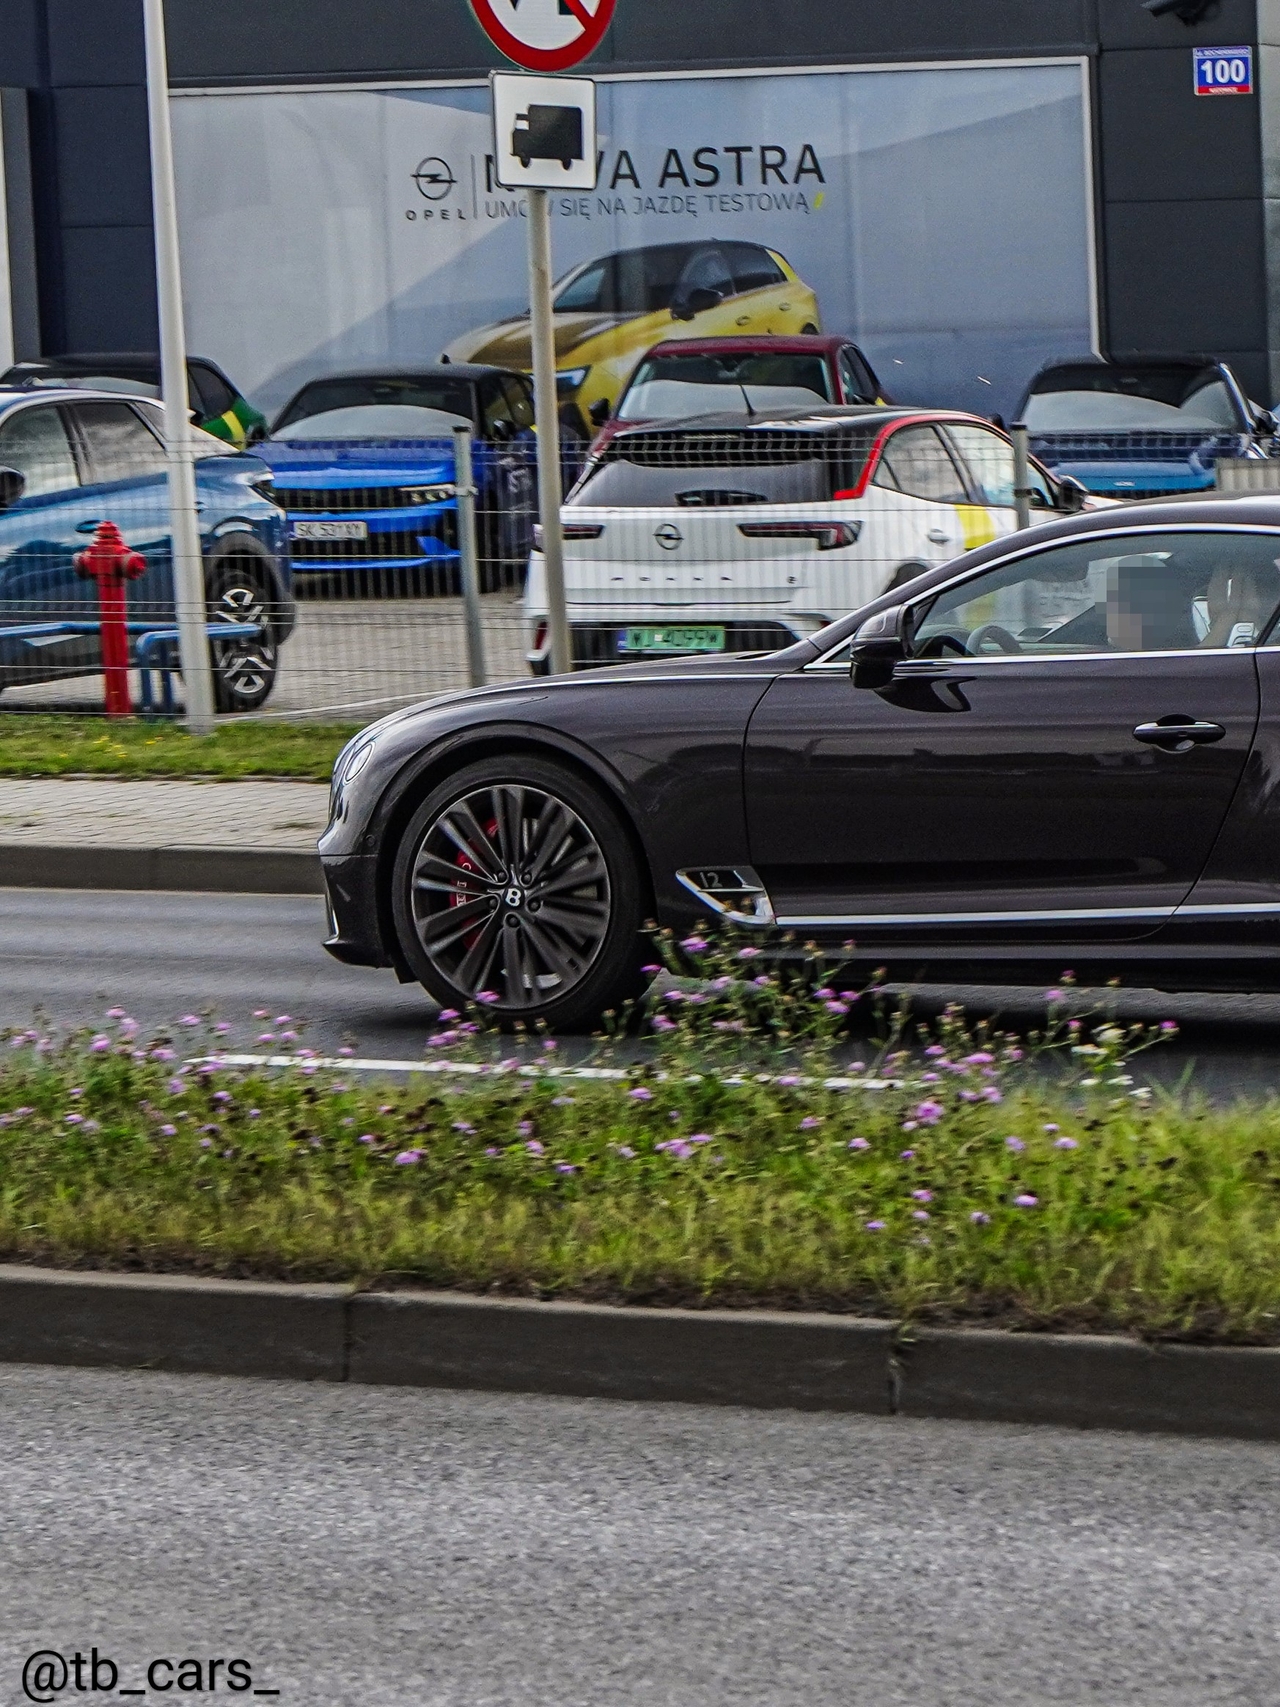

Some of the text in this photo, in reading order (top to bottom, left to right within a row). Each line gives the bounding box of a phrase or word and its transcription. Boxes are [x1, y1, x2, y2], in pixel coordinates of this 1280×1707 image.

[1200, 59, 1246, 84] 100
[485, 143, 827, 193] NA ASTRA
[405, 209, 466, 221] OPEL
[485, 198, 554, 219] UM
[597, 197, 627, 216] NA
[633, 194, 699, 218] JAZDĘ
[703, 191, 810, 214] TESTOWĄ
[699, 871, 723, 888] 12
[505, 888, 522, 907] B
